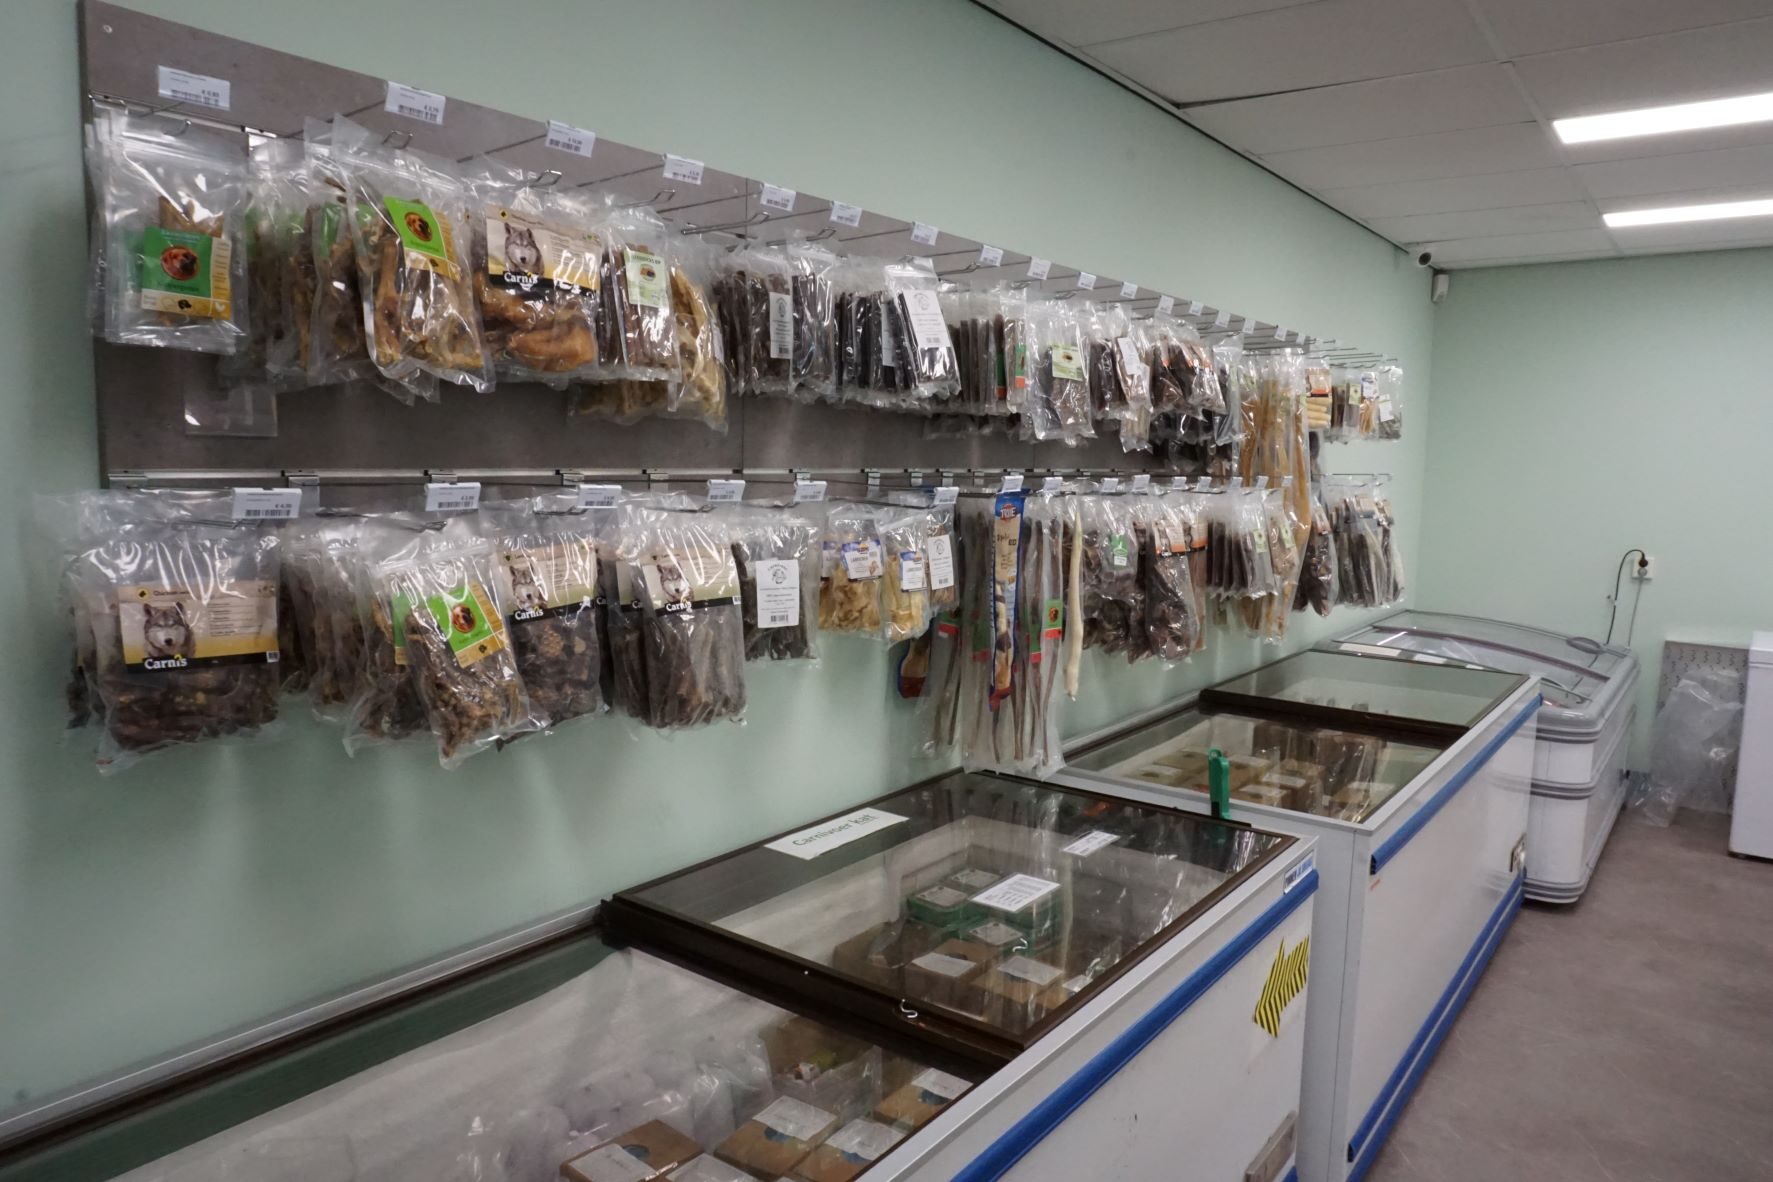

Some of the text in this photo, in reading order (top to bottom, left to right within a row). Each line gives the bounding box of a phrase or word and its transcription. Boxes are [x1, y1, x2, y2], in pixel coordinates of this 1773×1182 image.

[504, 271, 538, 284] Carnis
[514, 606, 544, 620] Carnis
[666, 600, 692, 612] Carnis
[144, 655, 188, 670] Carnis
[792, 823, 853, 846] Carnivoer
